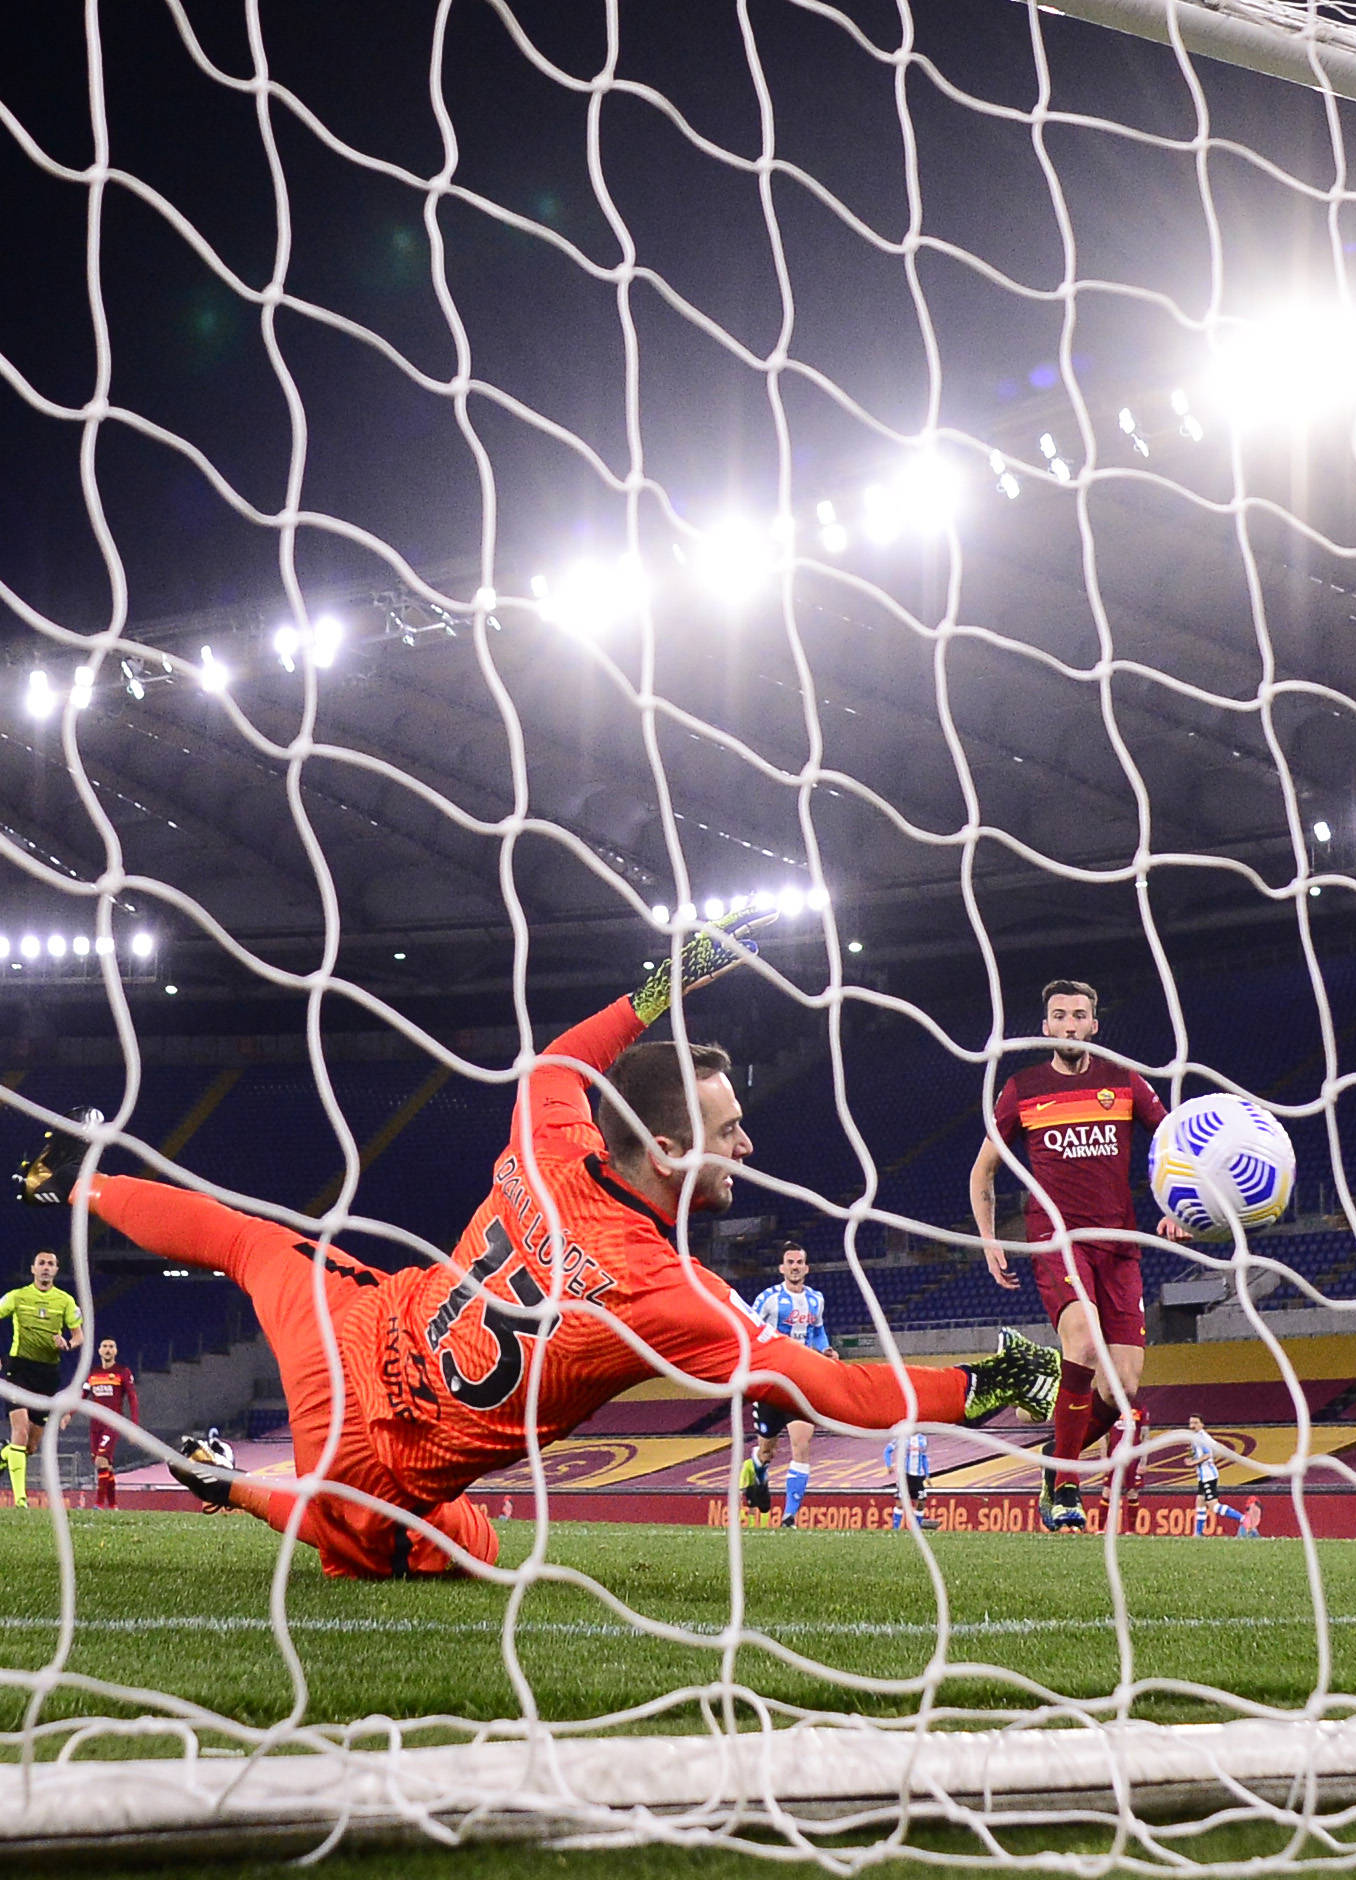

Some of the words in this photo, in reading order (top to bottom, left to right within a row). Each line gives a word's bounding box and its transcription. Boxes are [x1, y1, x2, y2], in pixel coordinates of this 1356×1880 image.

[1043, 1124, 1118, 1152] QATAR
[1062, 1143, 1119, 1159] AIRWAYS
[794, 1505, 862, 1530] ersona
[866, 1499, 879, 1530] è
[978, 1499, 1023, 1532] solo
[1028, 1499, 1035, 1532] i
